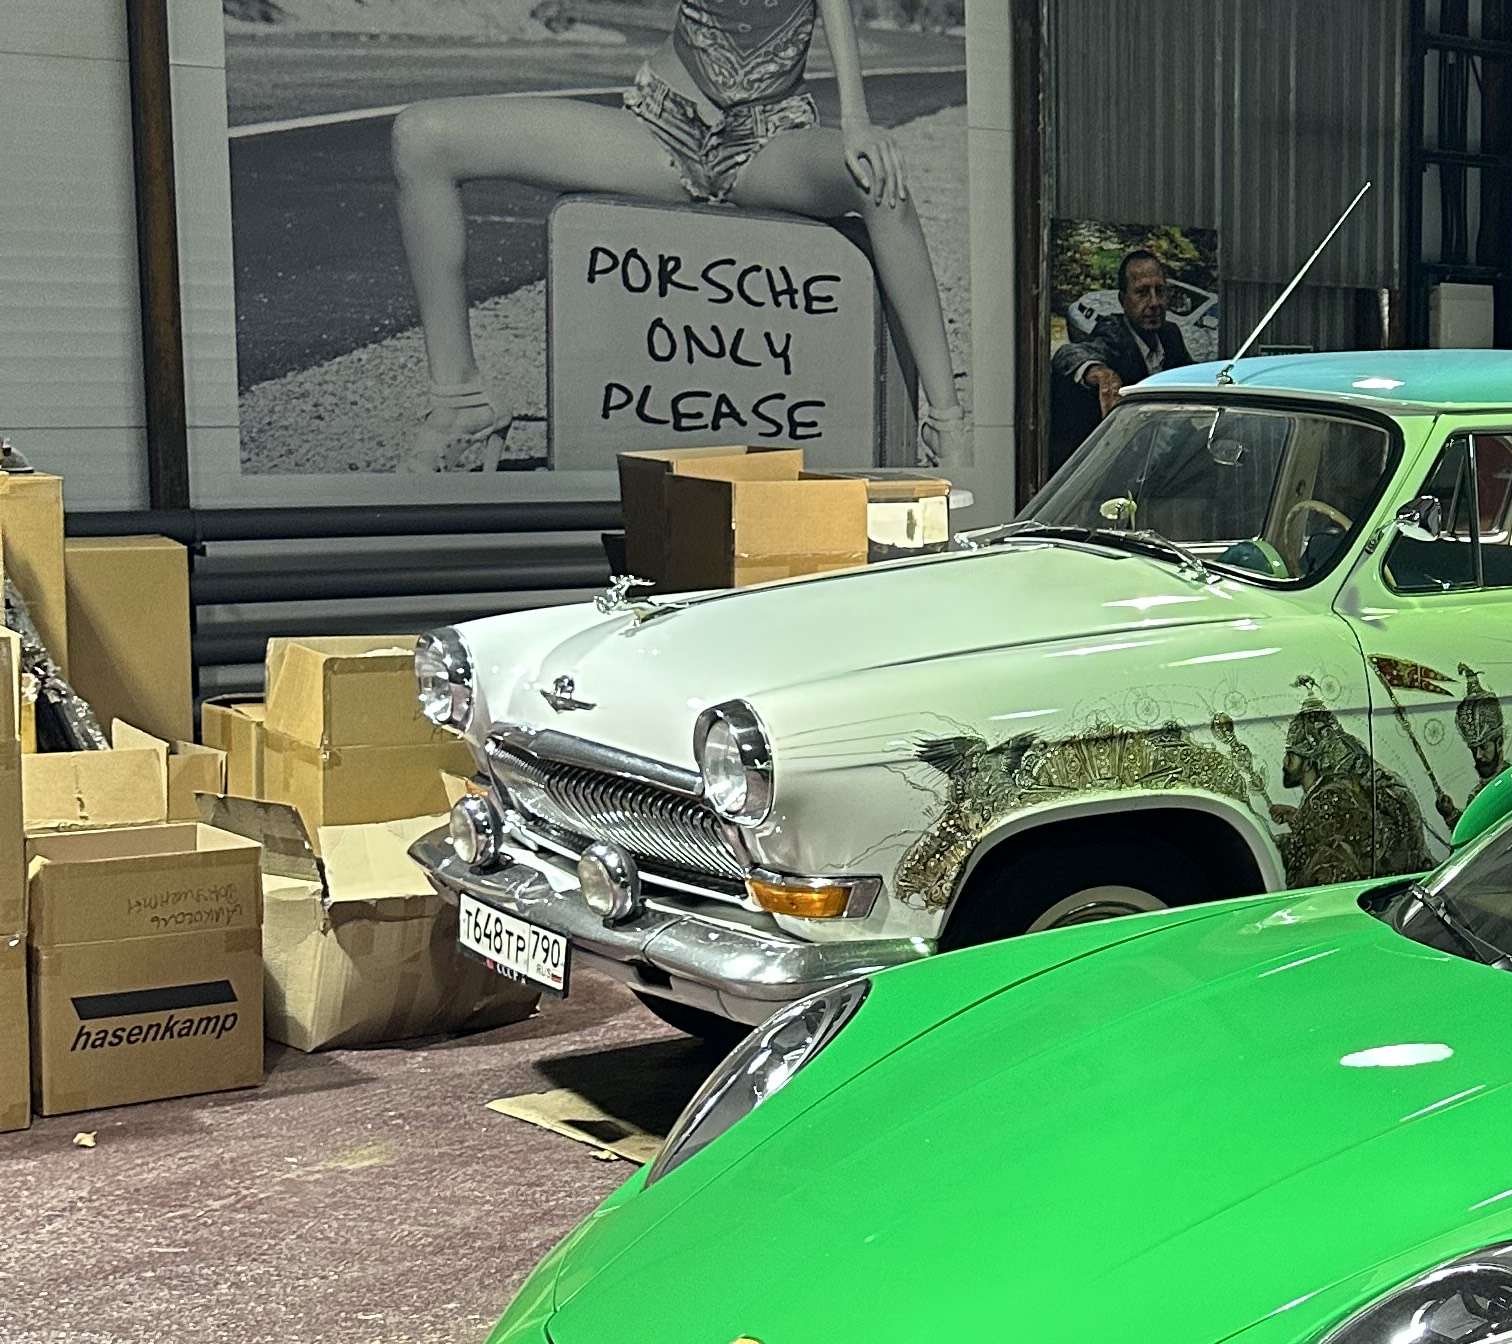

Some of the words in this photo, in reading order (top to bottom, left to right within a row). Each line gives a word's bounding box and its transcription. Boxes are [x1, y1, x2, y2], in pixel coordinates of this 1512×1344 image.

[587, 246, 842, 315] PORSCHE
[647, 317, 792, 376] ONLY
[601, 382, 826, 440] PLEASE
[532, 930, 560, 968] 790
[70, 1012, 238, 1052] hasenkamp
